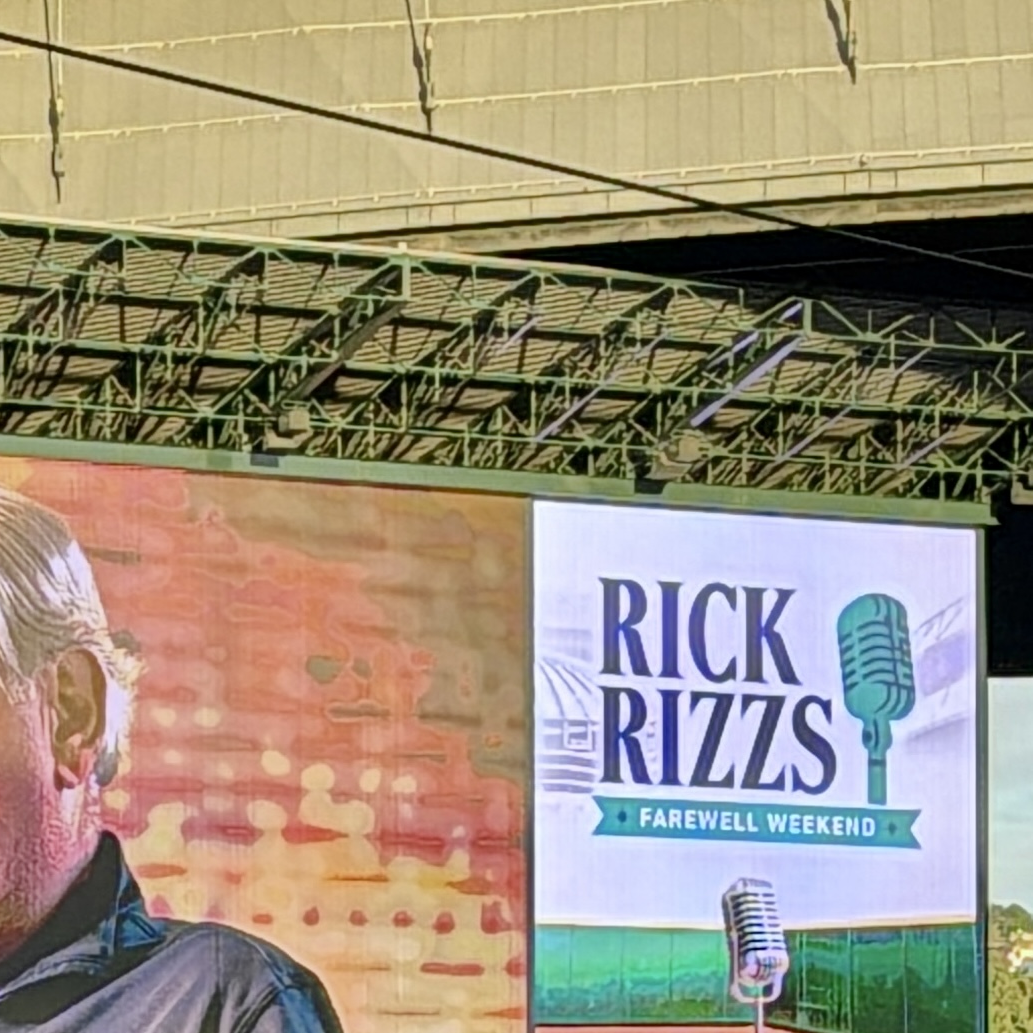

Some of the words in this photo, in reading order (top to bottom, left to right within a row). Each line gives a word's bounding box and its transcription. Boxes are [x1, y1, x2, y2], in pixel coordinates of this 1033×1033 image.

[598, 577, 802, 686] RICK
[597, 685, 837, 795] RIZZS
[639, 807, 759, 833] FAREWELL
[767, 812, 876, 837] WEEKEND
